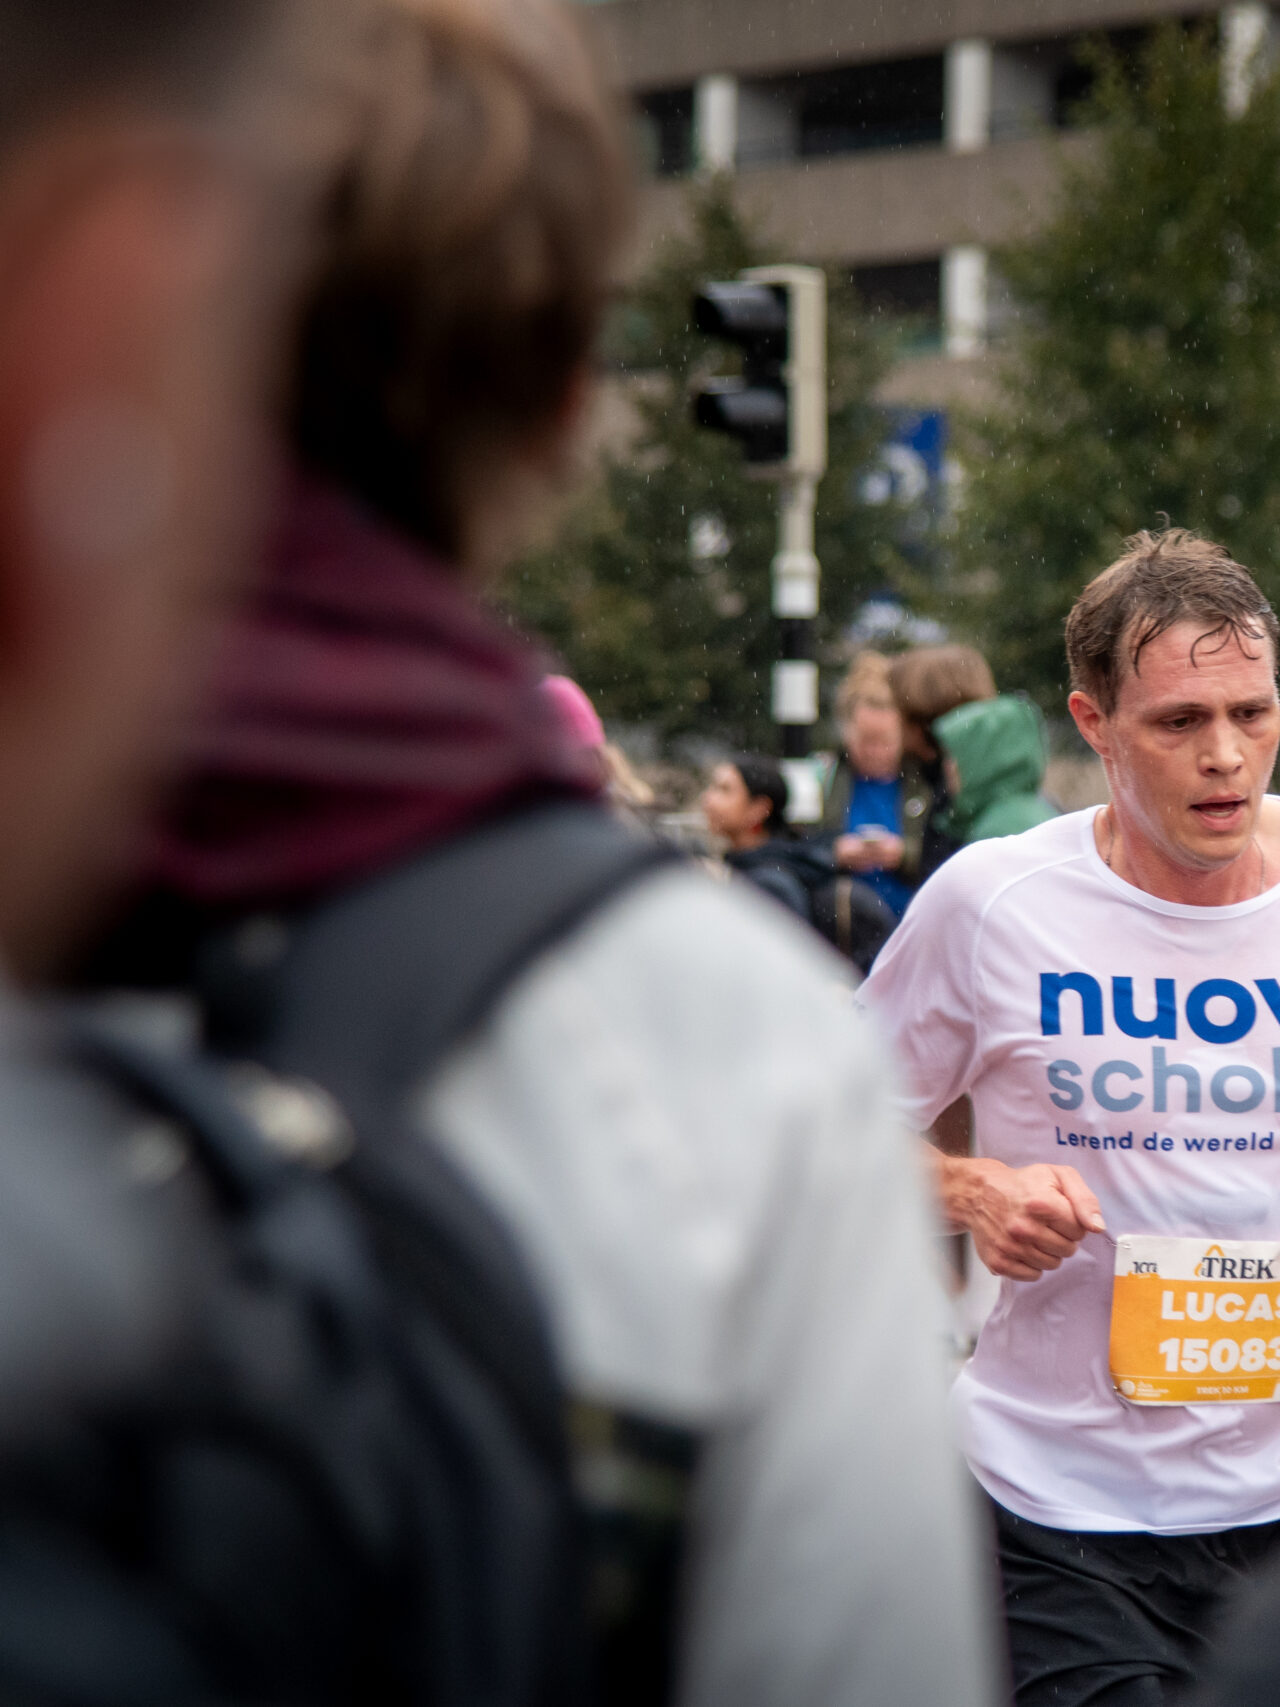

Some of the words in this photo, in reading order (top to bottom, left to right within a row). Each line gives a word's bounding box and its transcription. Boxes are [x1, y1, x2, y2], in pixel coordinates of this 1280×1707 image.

[1056, 1126, 1132, 1150] Lerend
[1143, 1129, 1175, 1152] de
[1184, 1131, 1273, 1152] wereld
[1202, 1256, 1275, 1279] TREK
